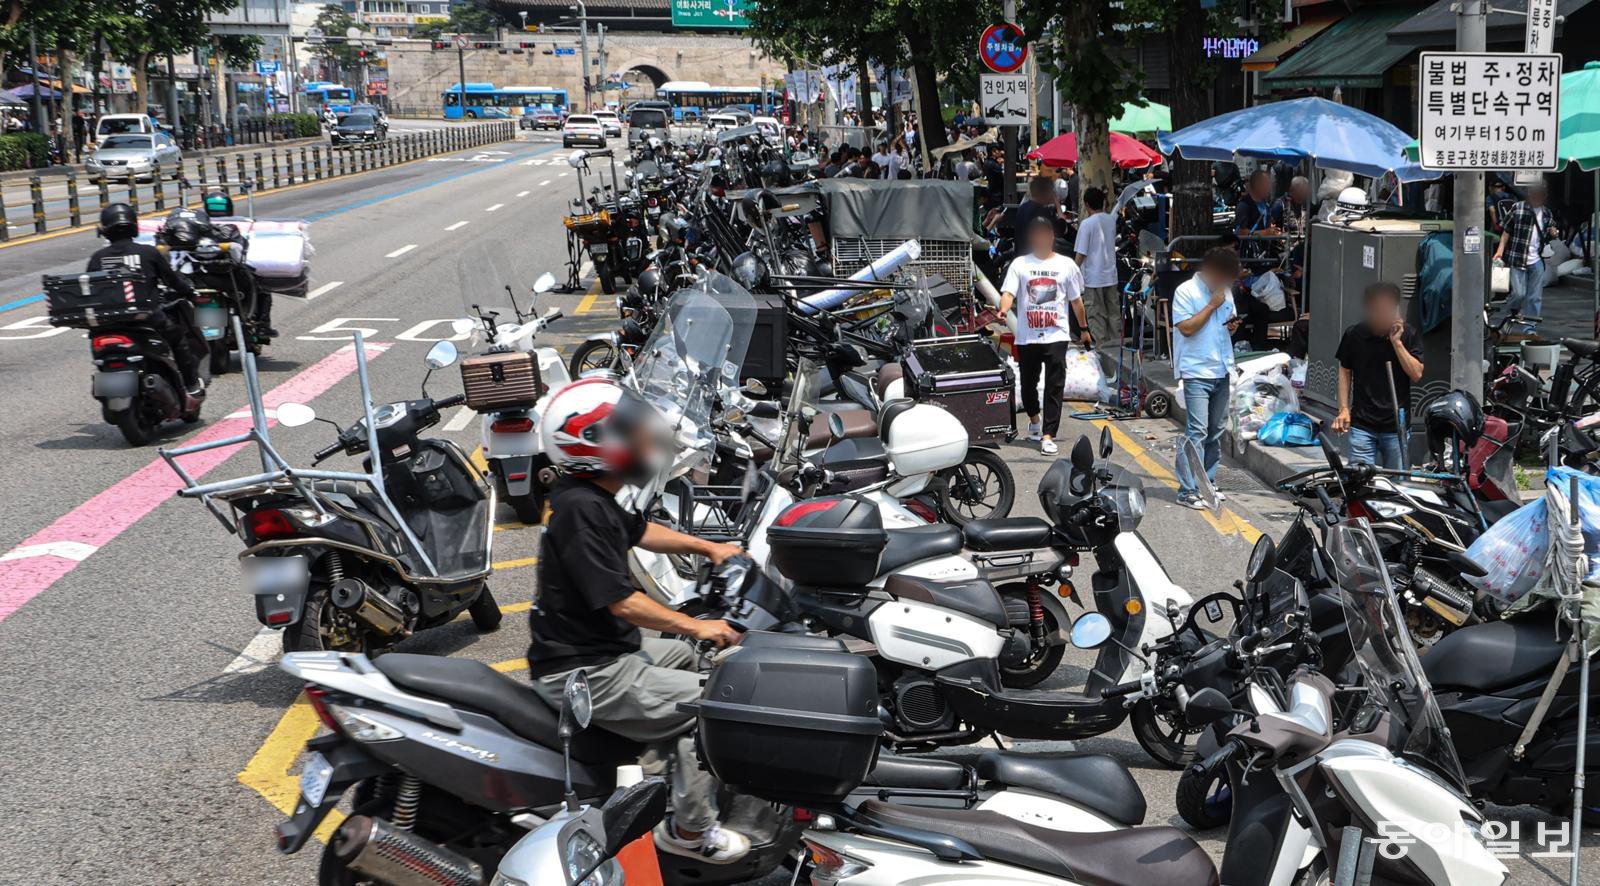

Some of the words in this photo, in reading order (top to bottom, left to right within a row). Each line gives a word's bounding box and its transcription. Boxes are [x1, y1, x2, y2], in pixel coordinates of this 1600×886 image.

[1428, 60, 1466, 86] 불법
[1483, 61, 1555, 87] 주·정차
[983, 79, 1027, 95] 견인지역
[1427, 91, 1552, 117] 특별단속구역
[295, 317, 474, 342] 50
